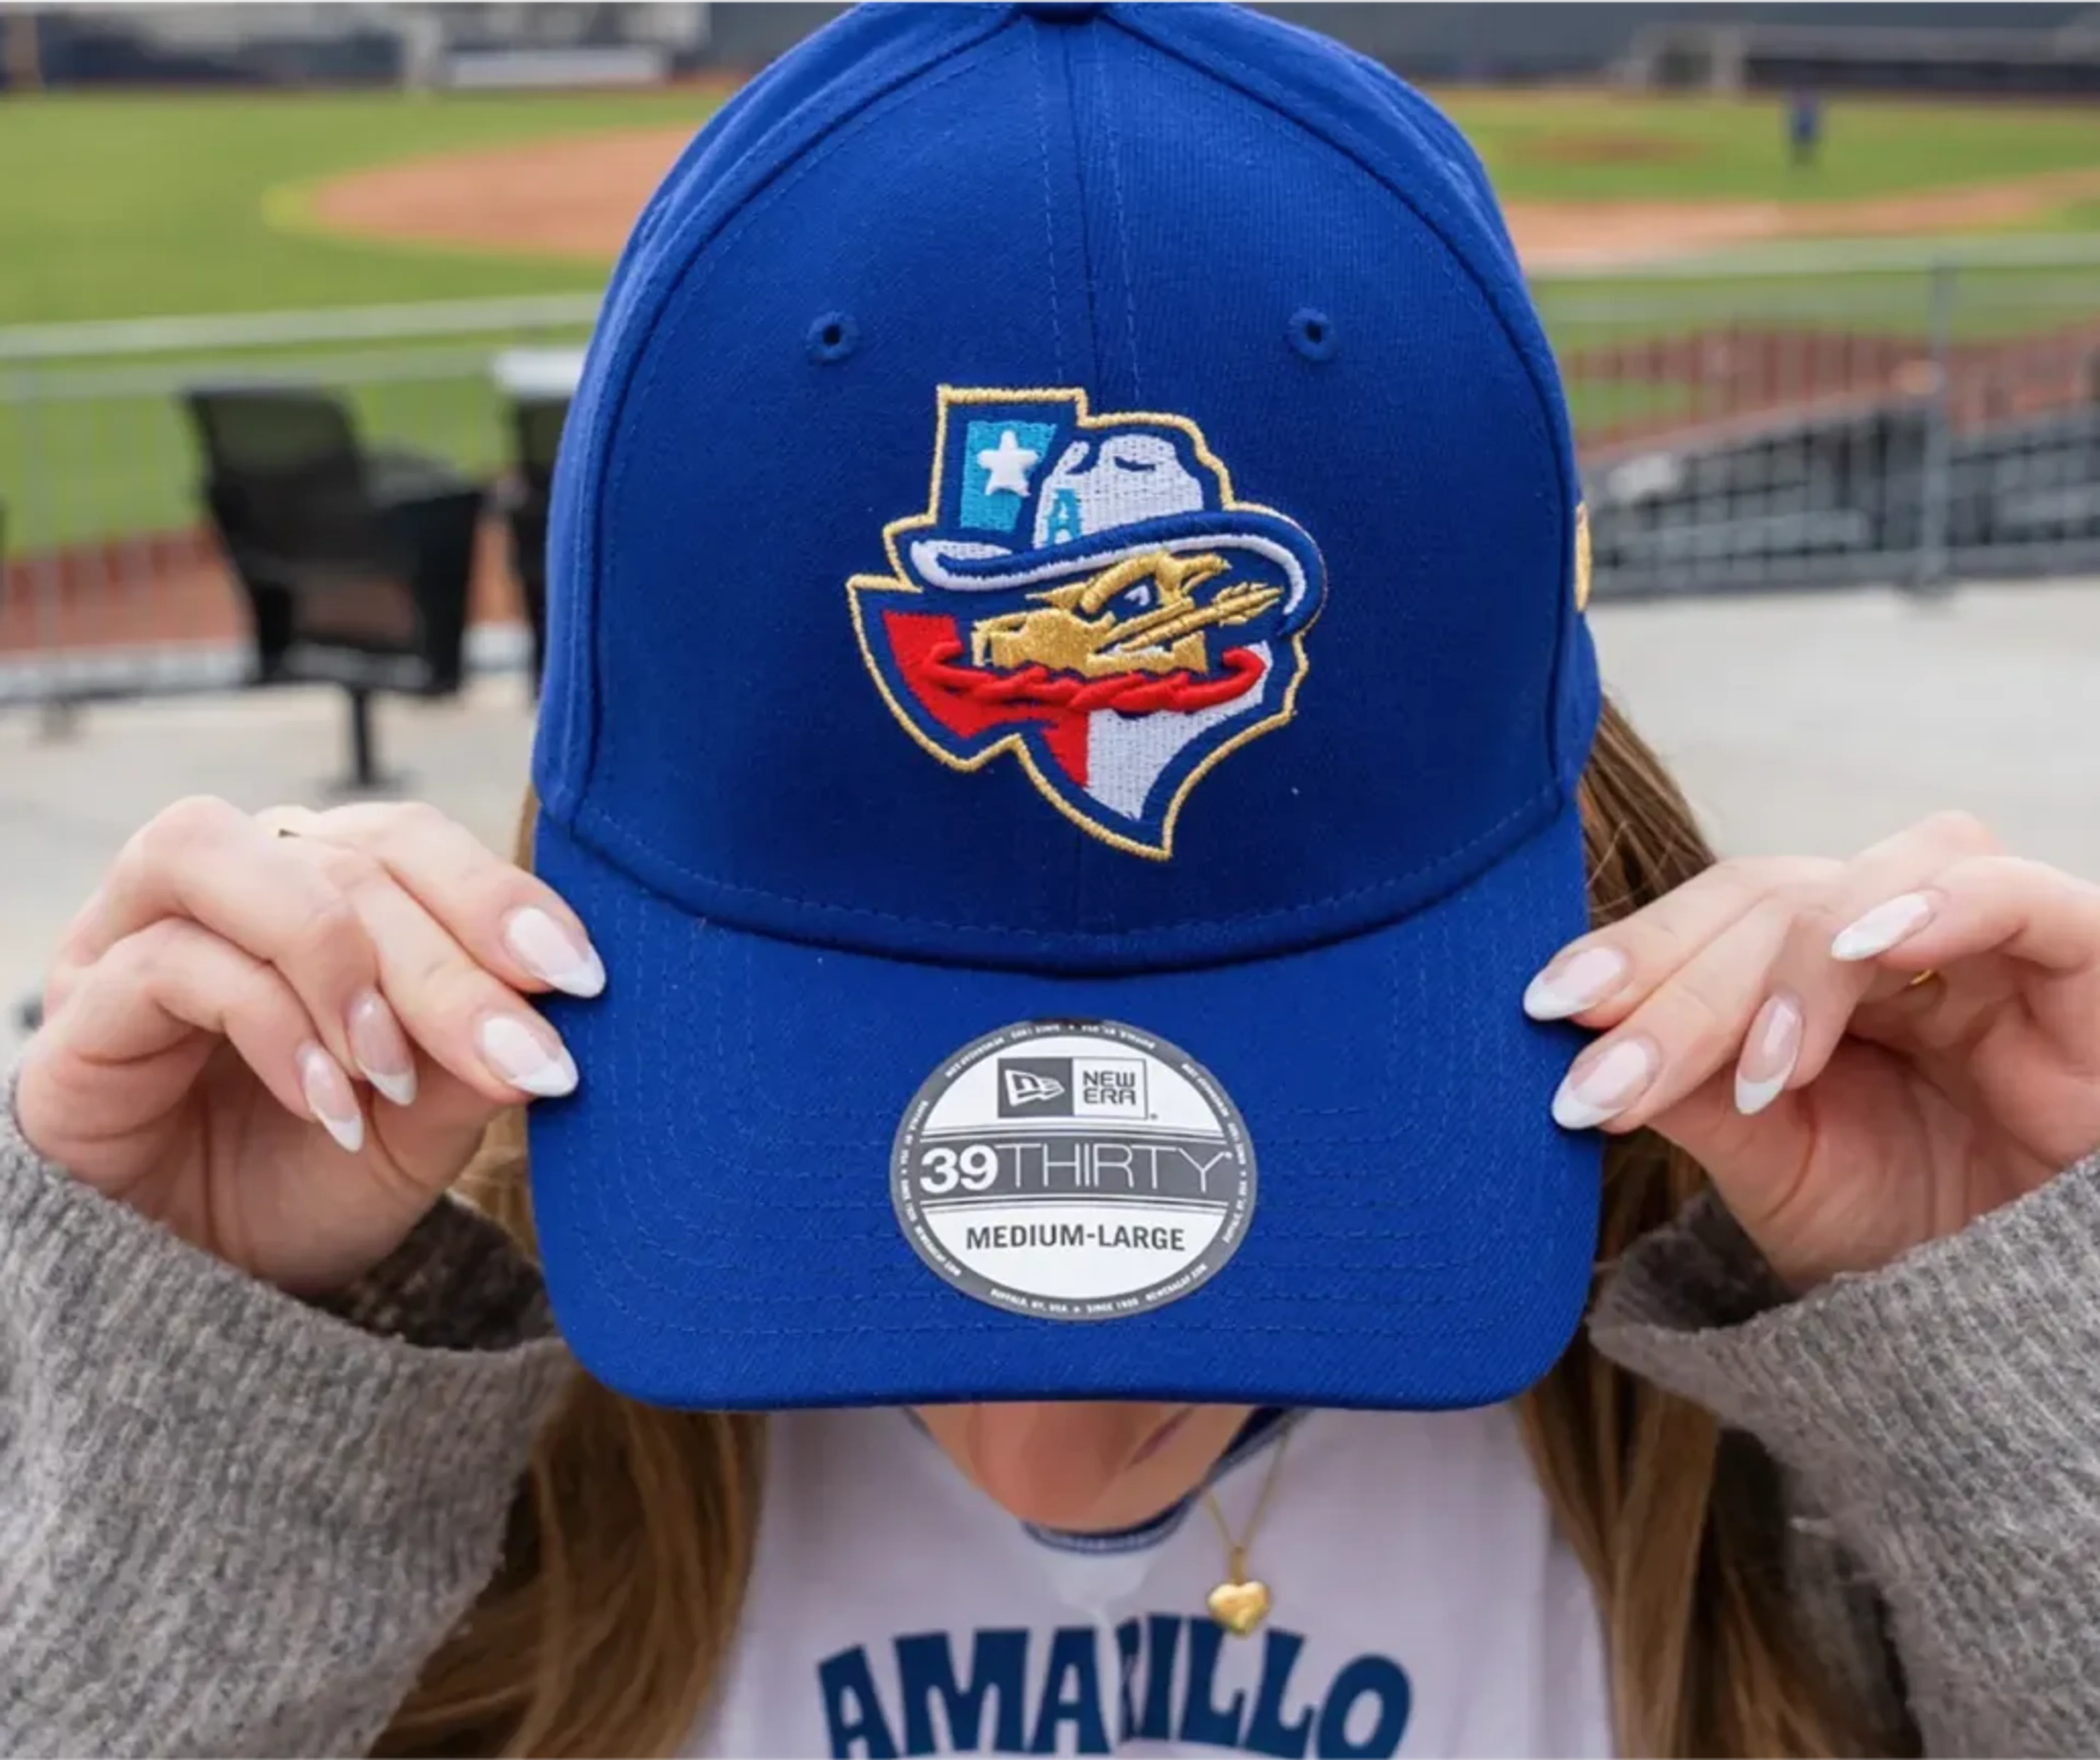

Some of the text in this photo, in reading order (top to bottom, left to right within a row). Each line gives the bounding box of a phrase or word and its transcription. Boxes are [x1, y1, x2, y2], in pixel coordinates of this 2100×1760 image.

[1047, 488, 1082, 546] A
[1083, 1070, 1135, 1087] NEW
[1083, 1088, 1136, 1105] ERA
[920, 1143, 1226, 1194] 39THIRTY
[966, 1224, 1185, 1251] MEDIUM-LARGE
